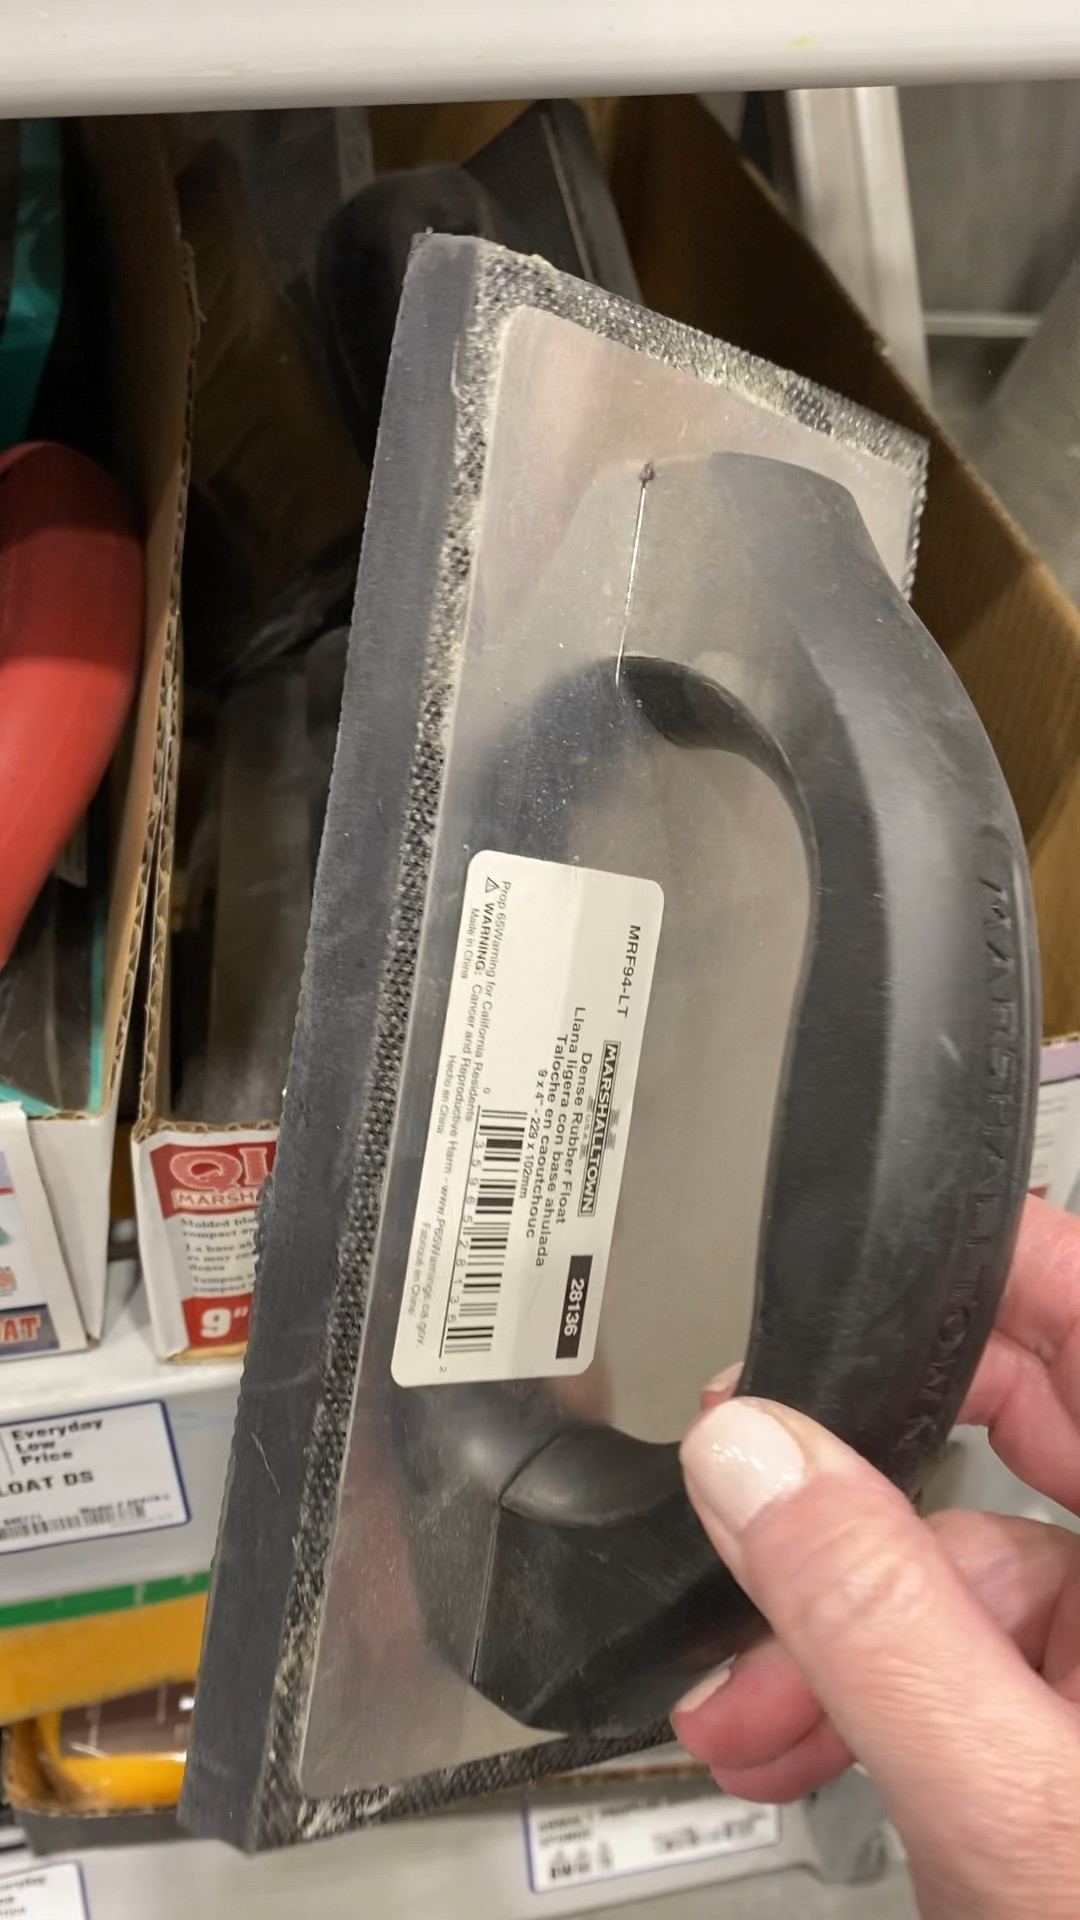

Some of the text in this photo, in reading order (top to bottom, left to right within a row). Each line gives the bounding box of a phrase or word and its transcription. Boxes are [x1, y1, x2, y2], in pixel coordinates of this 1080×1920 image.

[459, 907, 479, 979] Made in China
[473, 902, 494, 975] WARNING:
[616, 924, 640, 1018] MRF94-LT
[464, 880, 511, 1121] Prop 65Warning for California Residents
[465, 983, 481, 1028] Cancer
[461, 1031, 474, 1054] and
[537, 1069, 547, 1077] 9
[436, 1055, 456, 1133] Hecho en China
[447, 1058, 470, 1136] Reproductive
[526, 1034, 567, 1238] Taloche en caoutchouc
[528, 1117, 540, 1139] 229
[535, 1006, 585, 1266] Llana ligera con base ahulada
[555, 1052, 592, 1223] Dense Rubber Float
[580, 1043, 617, 1212] MARSHALLTOWN
[442, 1140, 456, 1173] Harm
[518, 1154, 534, 1198] 102mm
[178, 1191, 257, 1206] MARSH
[183, 1229, 237, 1240] compact
[206, 1243, 235, 1253] base
[411, 1269, 421, 1281] en
[407, 1284, 420, 1313] Chine
[562, 1278, 584, 1335] 28136
[0, 1312, 40, 1342] AT
[200, 1307, 248, 1339] 9"
[12, 1418, 103, 1441] Everyday
[15, 1440, 56, 1454] Low
[21, 1450, 73, 1467] Price
[63, 1470, 94, 1486] DS
